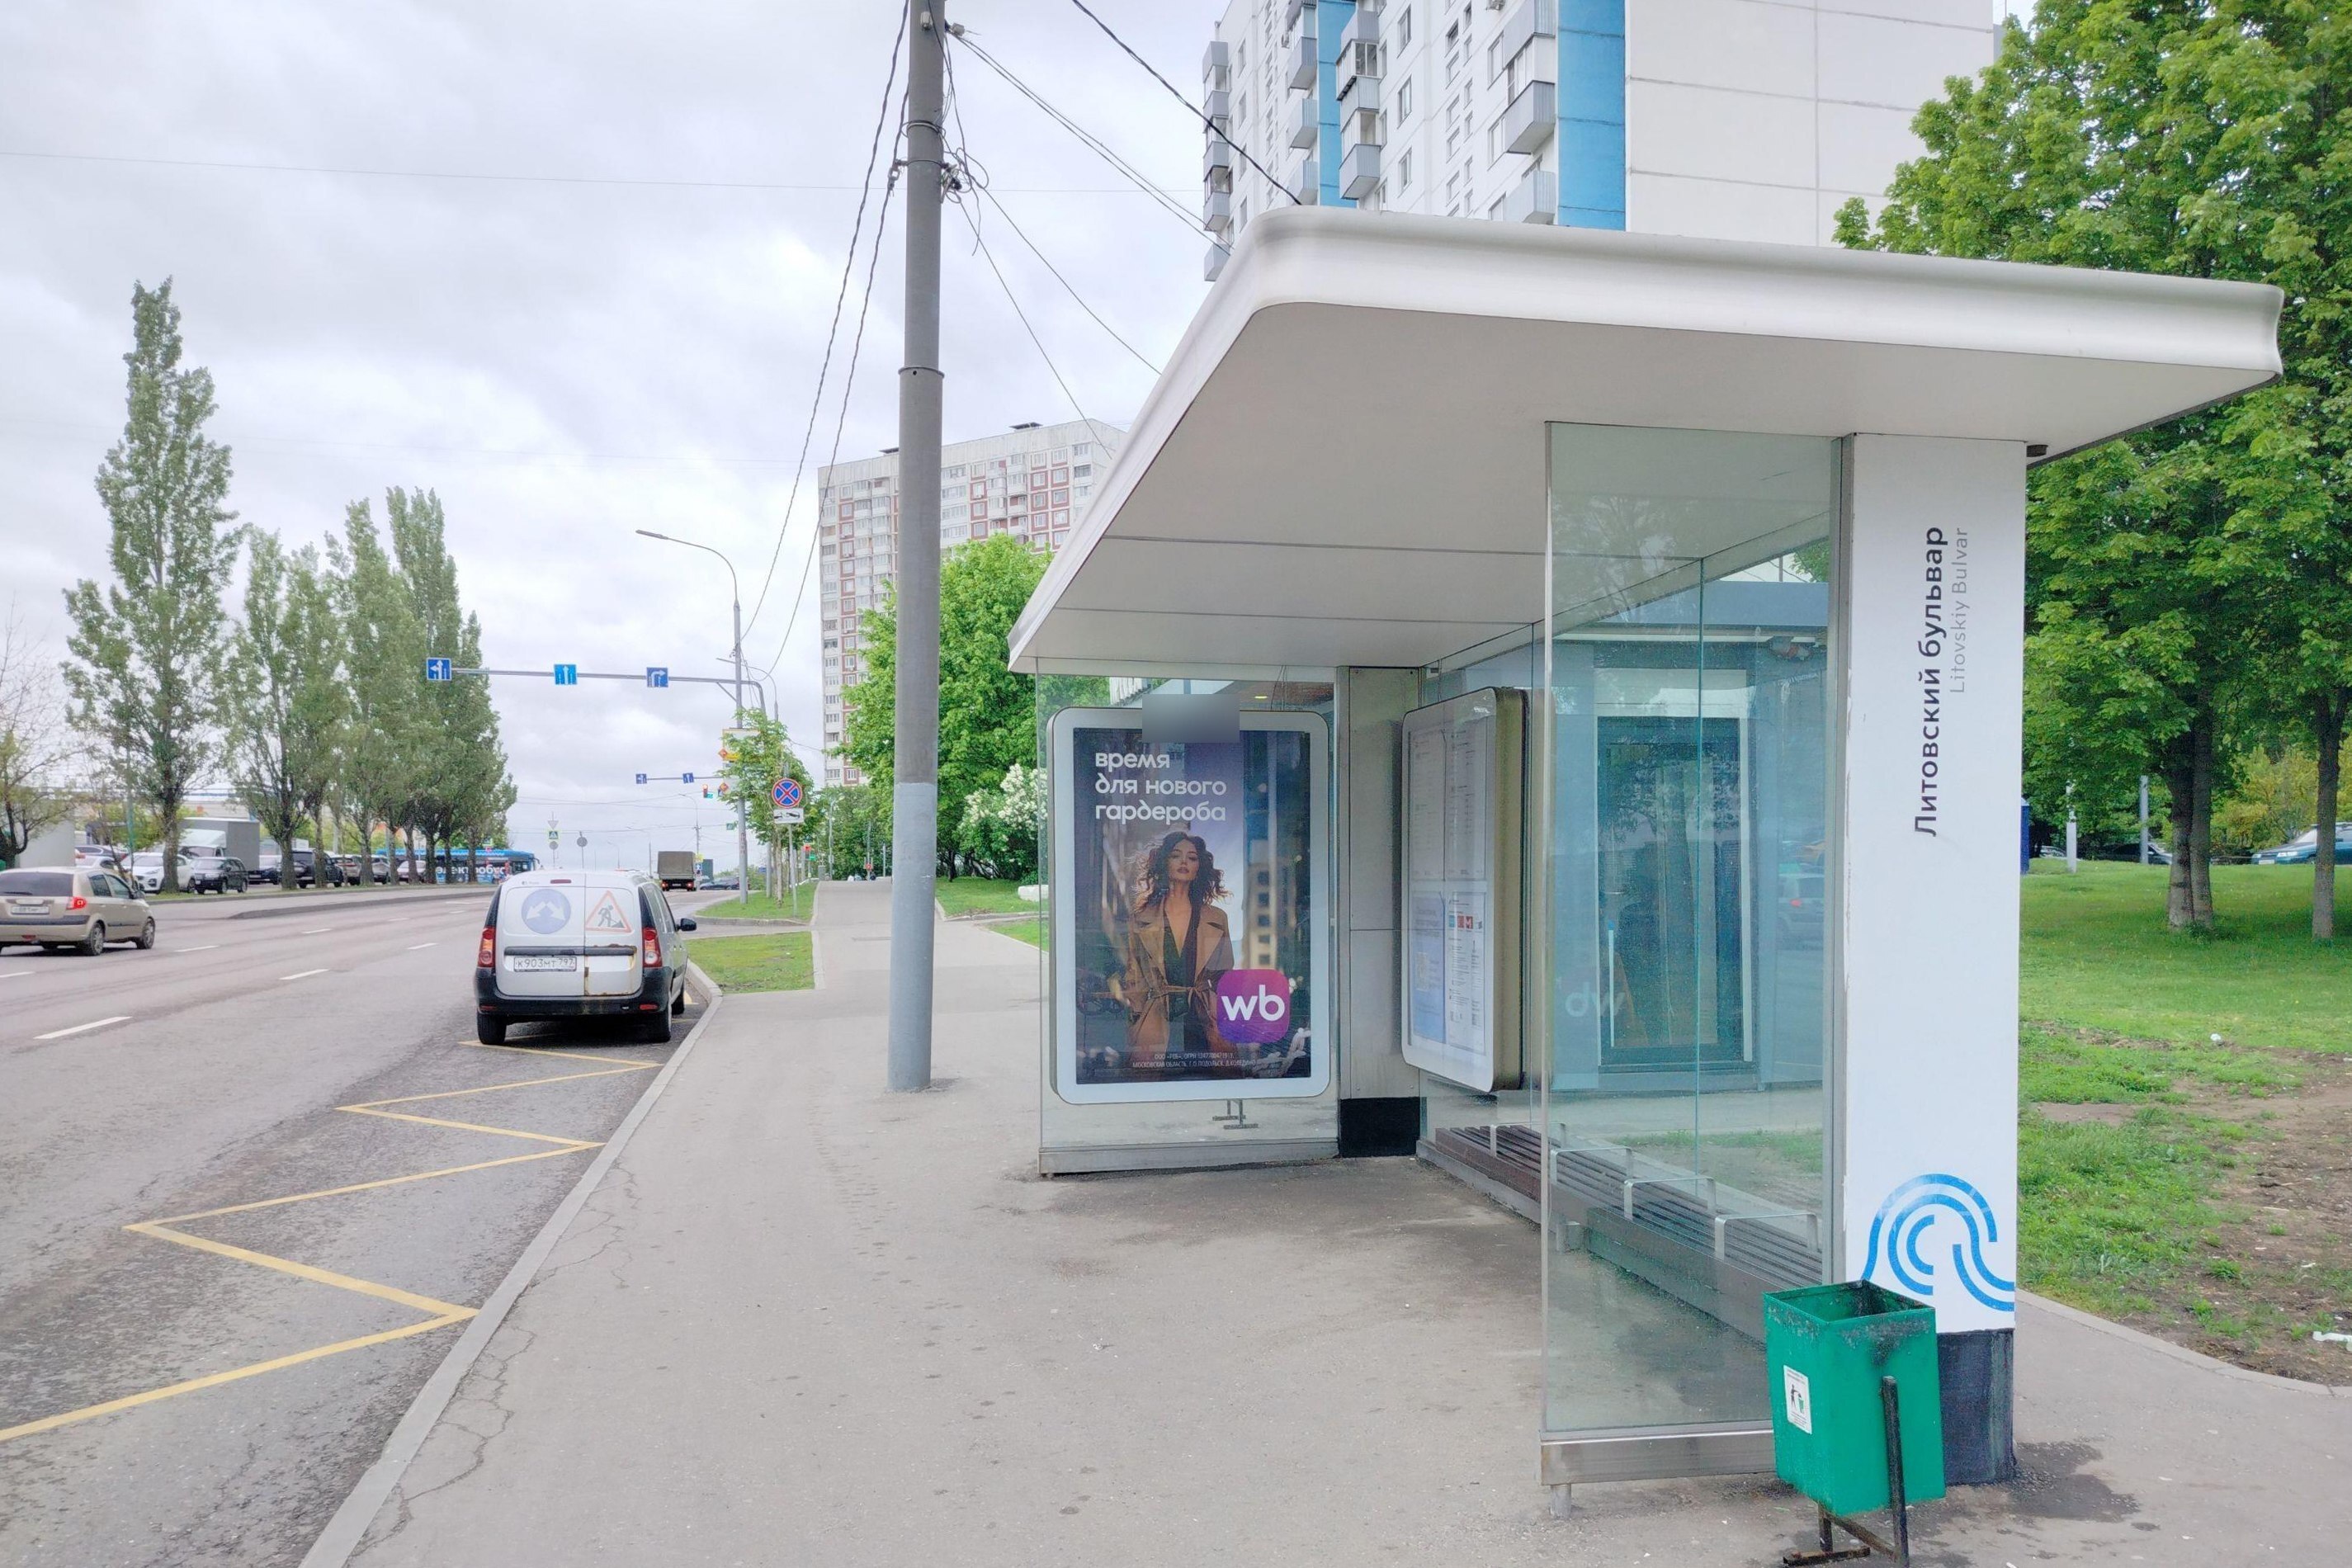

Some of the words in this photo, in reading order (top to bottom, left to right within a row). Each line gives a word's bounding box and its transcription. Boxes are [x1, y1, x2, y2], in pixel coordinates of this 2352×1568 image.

[1951, 527, 1968, 594] Bulvar
[1918, 527, 1948, 658] бульвар
[1949, 601, 1970, 693] Litovskiy
[1095, 752, 1170, 772] время
[1914, 668, 1940, 837] Литовский
[1095, 772, 1138, 794] для
[1145, 780, 1227, 796] нового
[1095, 799, 1226, 825] гардероба
[1221, 984, 1286, 1022] wb
